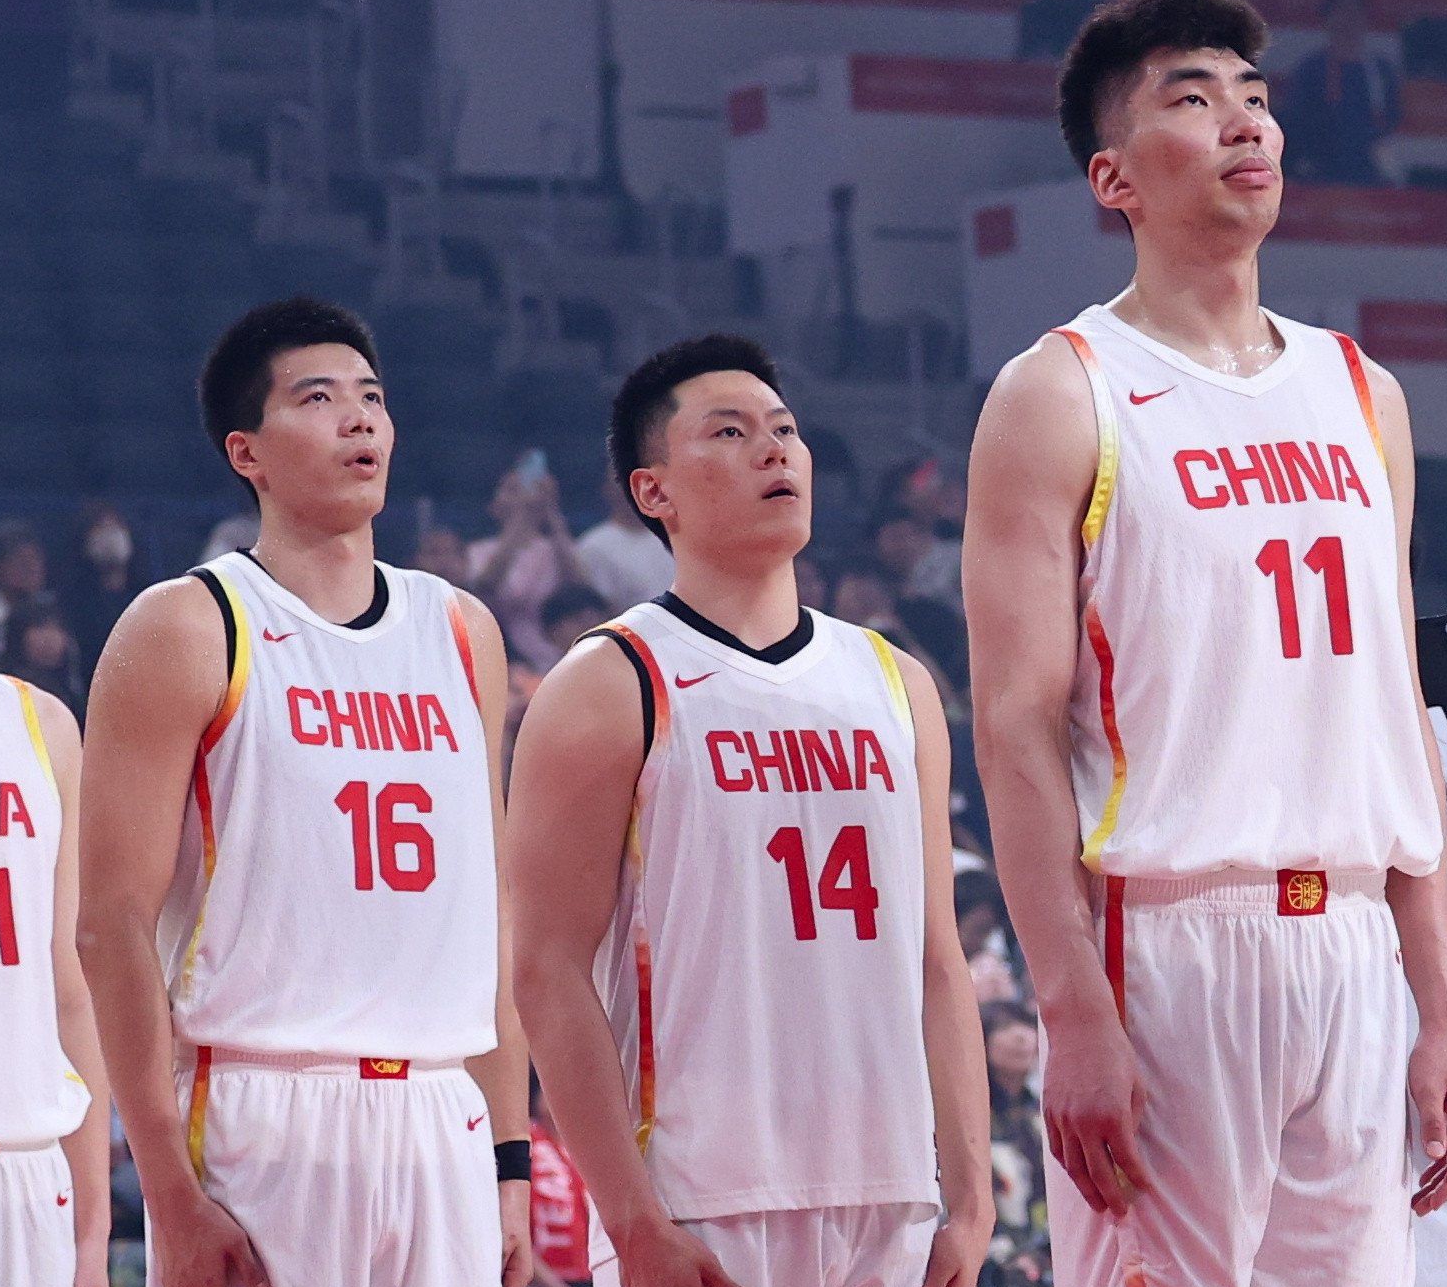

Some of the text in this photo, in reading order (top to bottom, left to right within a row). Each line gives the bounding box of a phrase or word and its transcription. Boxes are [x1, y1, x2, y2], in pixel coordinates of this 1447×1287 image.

[1173, 441, 1371, 510] CHINA
[1255, 536, 1354, 659] 11
[287, 685, 459, 752] CHINA
[705, 729, 895, 793] CHINA
[334, 780, 436, 892] 16
[766, 826, 879, 940] 14
